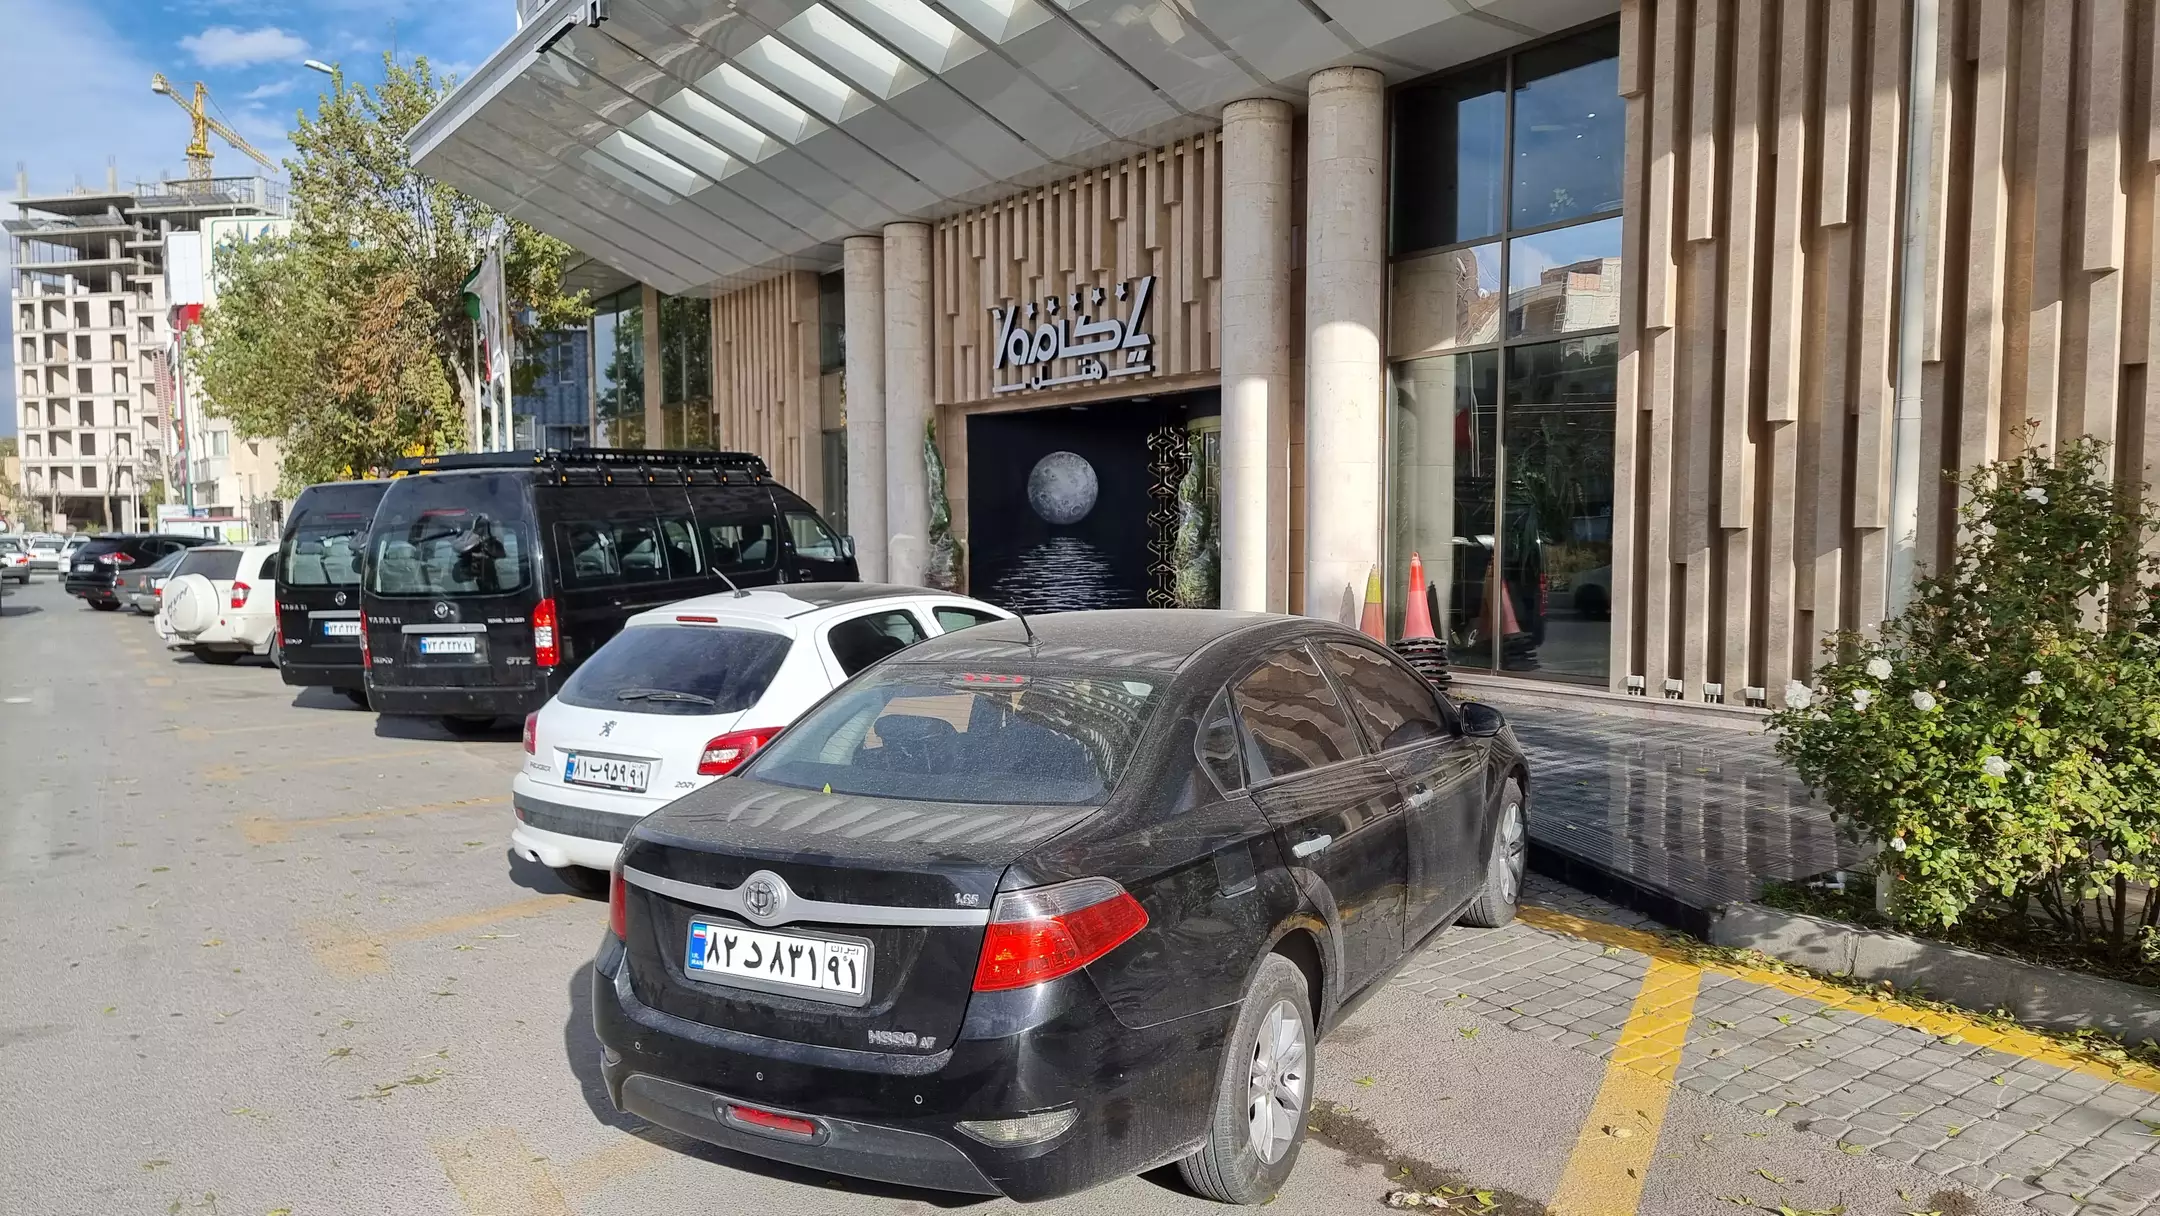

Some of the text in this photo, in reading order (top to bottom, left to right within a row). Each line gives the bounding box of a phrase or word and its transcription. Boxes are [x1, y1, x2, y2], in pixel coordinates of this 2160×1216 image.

[706, 931, 857, 989] ۸۲ د ۸۳۱ ۹۱
[830, 944, 859, 956] ایران
